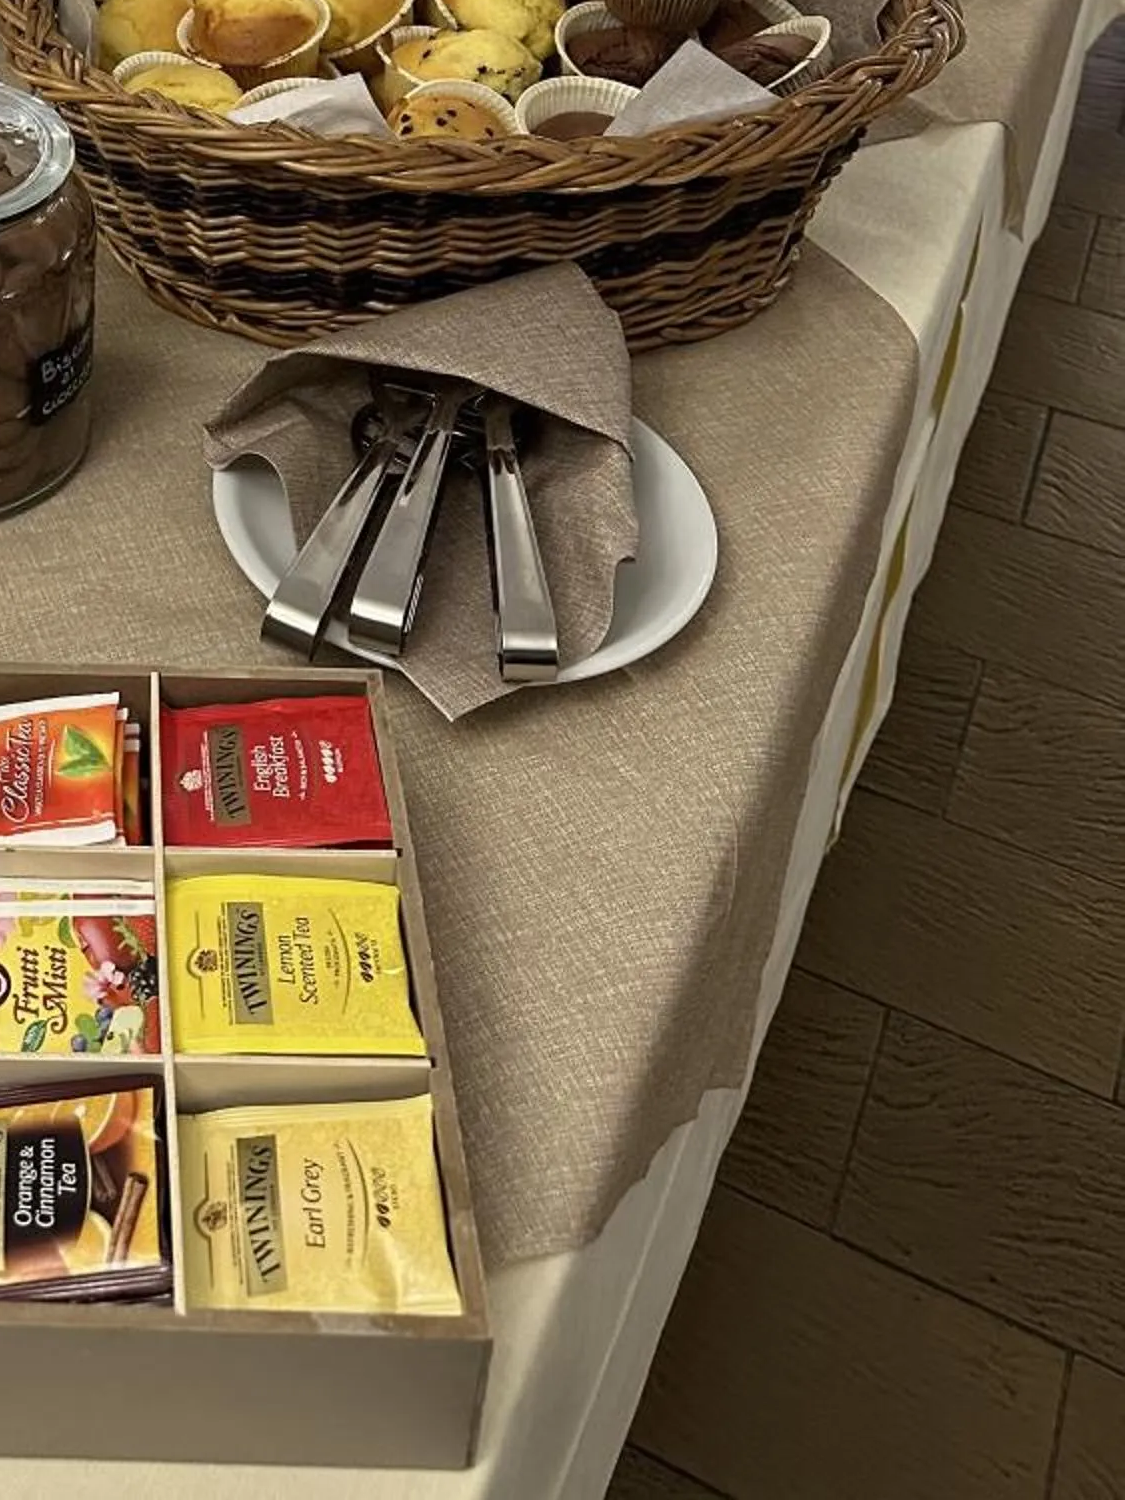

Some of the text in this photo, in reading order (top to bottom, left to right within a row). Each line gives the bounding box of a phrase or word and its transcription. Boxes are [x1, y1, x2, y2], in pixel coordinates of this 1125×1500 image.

[0, 719, 34, 823] Classic Tea
[216, 730, 246, 819] TWININGS
[251, 745, 273, 792] English
[270, 735, 291, 798] Breakfast
[13, 945, 40, 1025] Frutti
[43, 945, 68, 1034] Misti
[233, 907, 269, 1015] TWININGS
[277, 934, 296, 986] Lemon
[292, 916, 319, 1005] Scented Tea
[13, 1145, 37, 1227] Orange &
[35, 1137, 57, 1229] Cinnamon
[57, 1162, 77, 1196] Tea
[244, 1143, 282, 1284] TWININGS
[300, 1156, 326, 1250] Earl Grey
